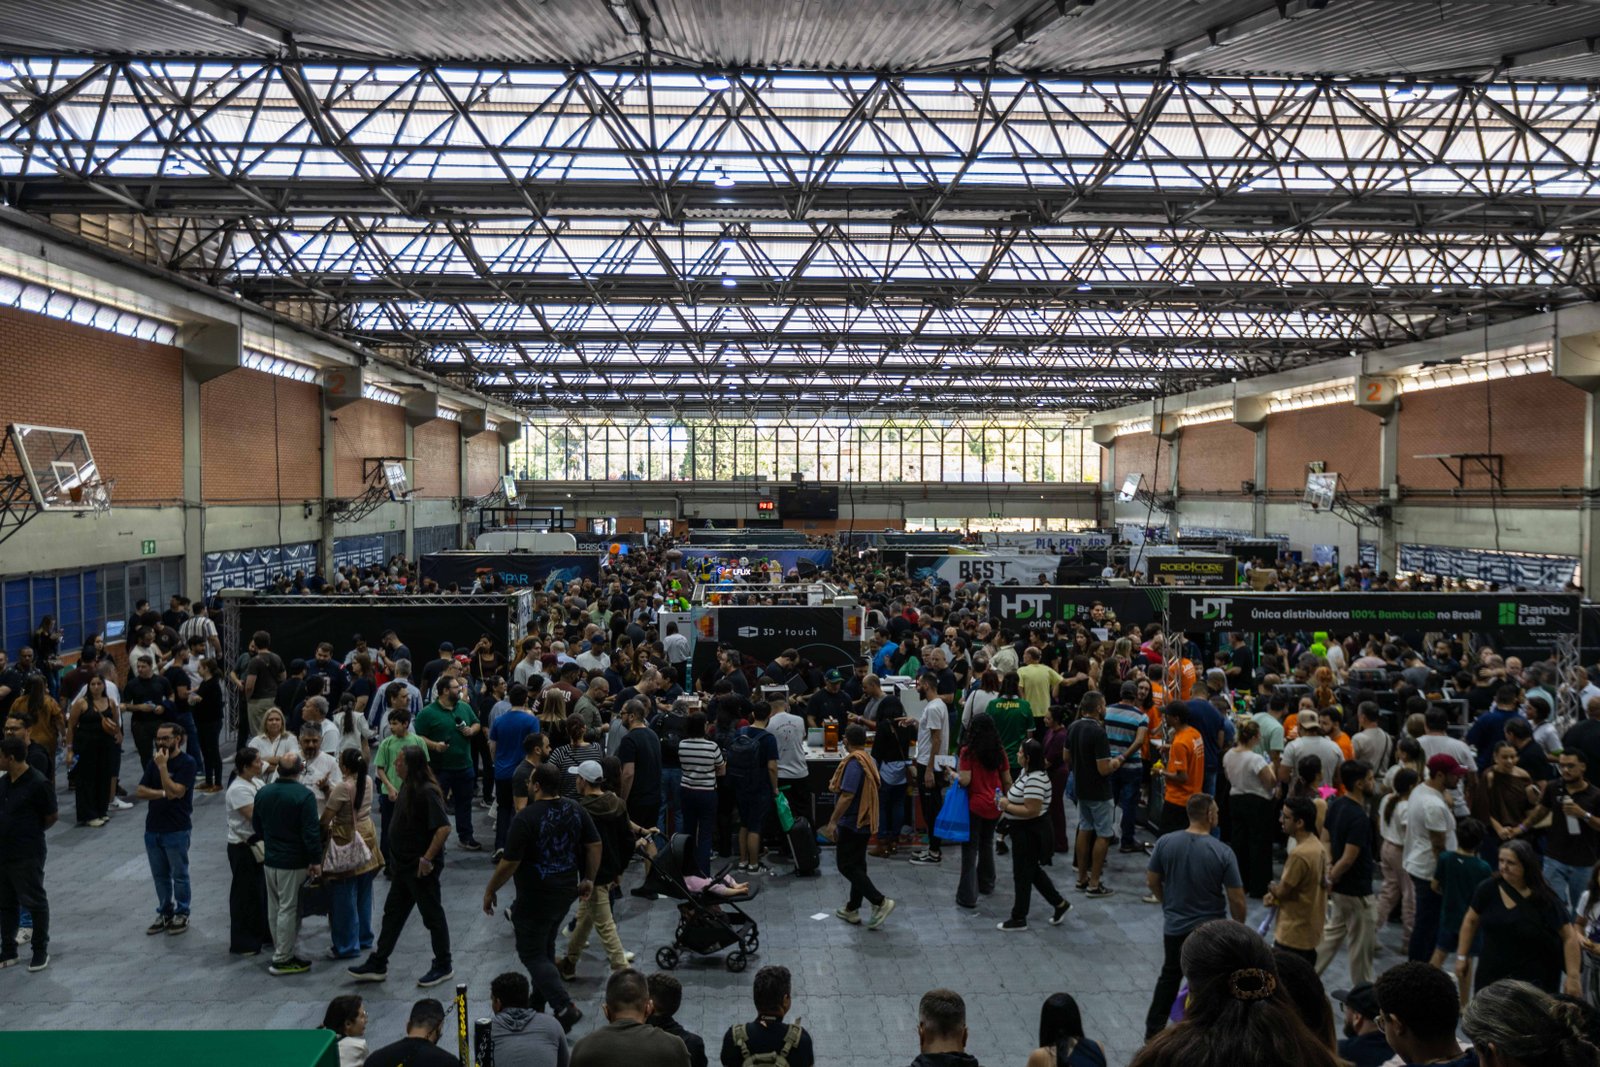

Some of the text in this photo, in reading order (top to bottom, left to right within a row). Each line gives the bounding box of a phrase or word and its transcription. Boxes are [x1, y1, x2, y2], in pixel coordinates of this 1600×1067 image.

[328, 374, 346, 395] 2
[1367, 383, 1383, 401] 2
[1251, 607, 1281, 619] Única
[1283, 608, 1350, 619] distribuidora
[1351, 610, 1376, 619] 100%
[1378, 610, 1416, 619] Bambu
[1417, 611, 1436, 619] Lab
[1452, 610, 1481, 620] Brasil
[1519, 604, 1570, 615] Bambu
[1214, 619, 1233, 628] print
[1519, 616, 1546, 625] Lab
[763, 627, 817, 636] 3D touch
